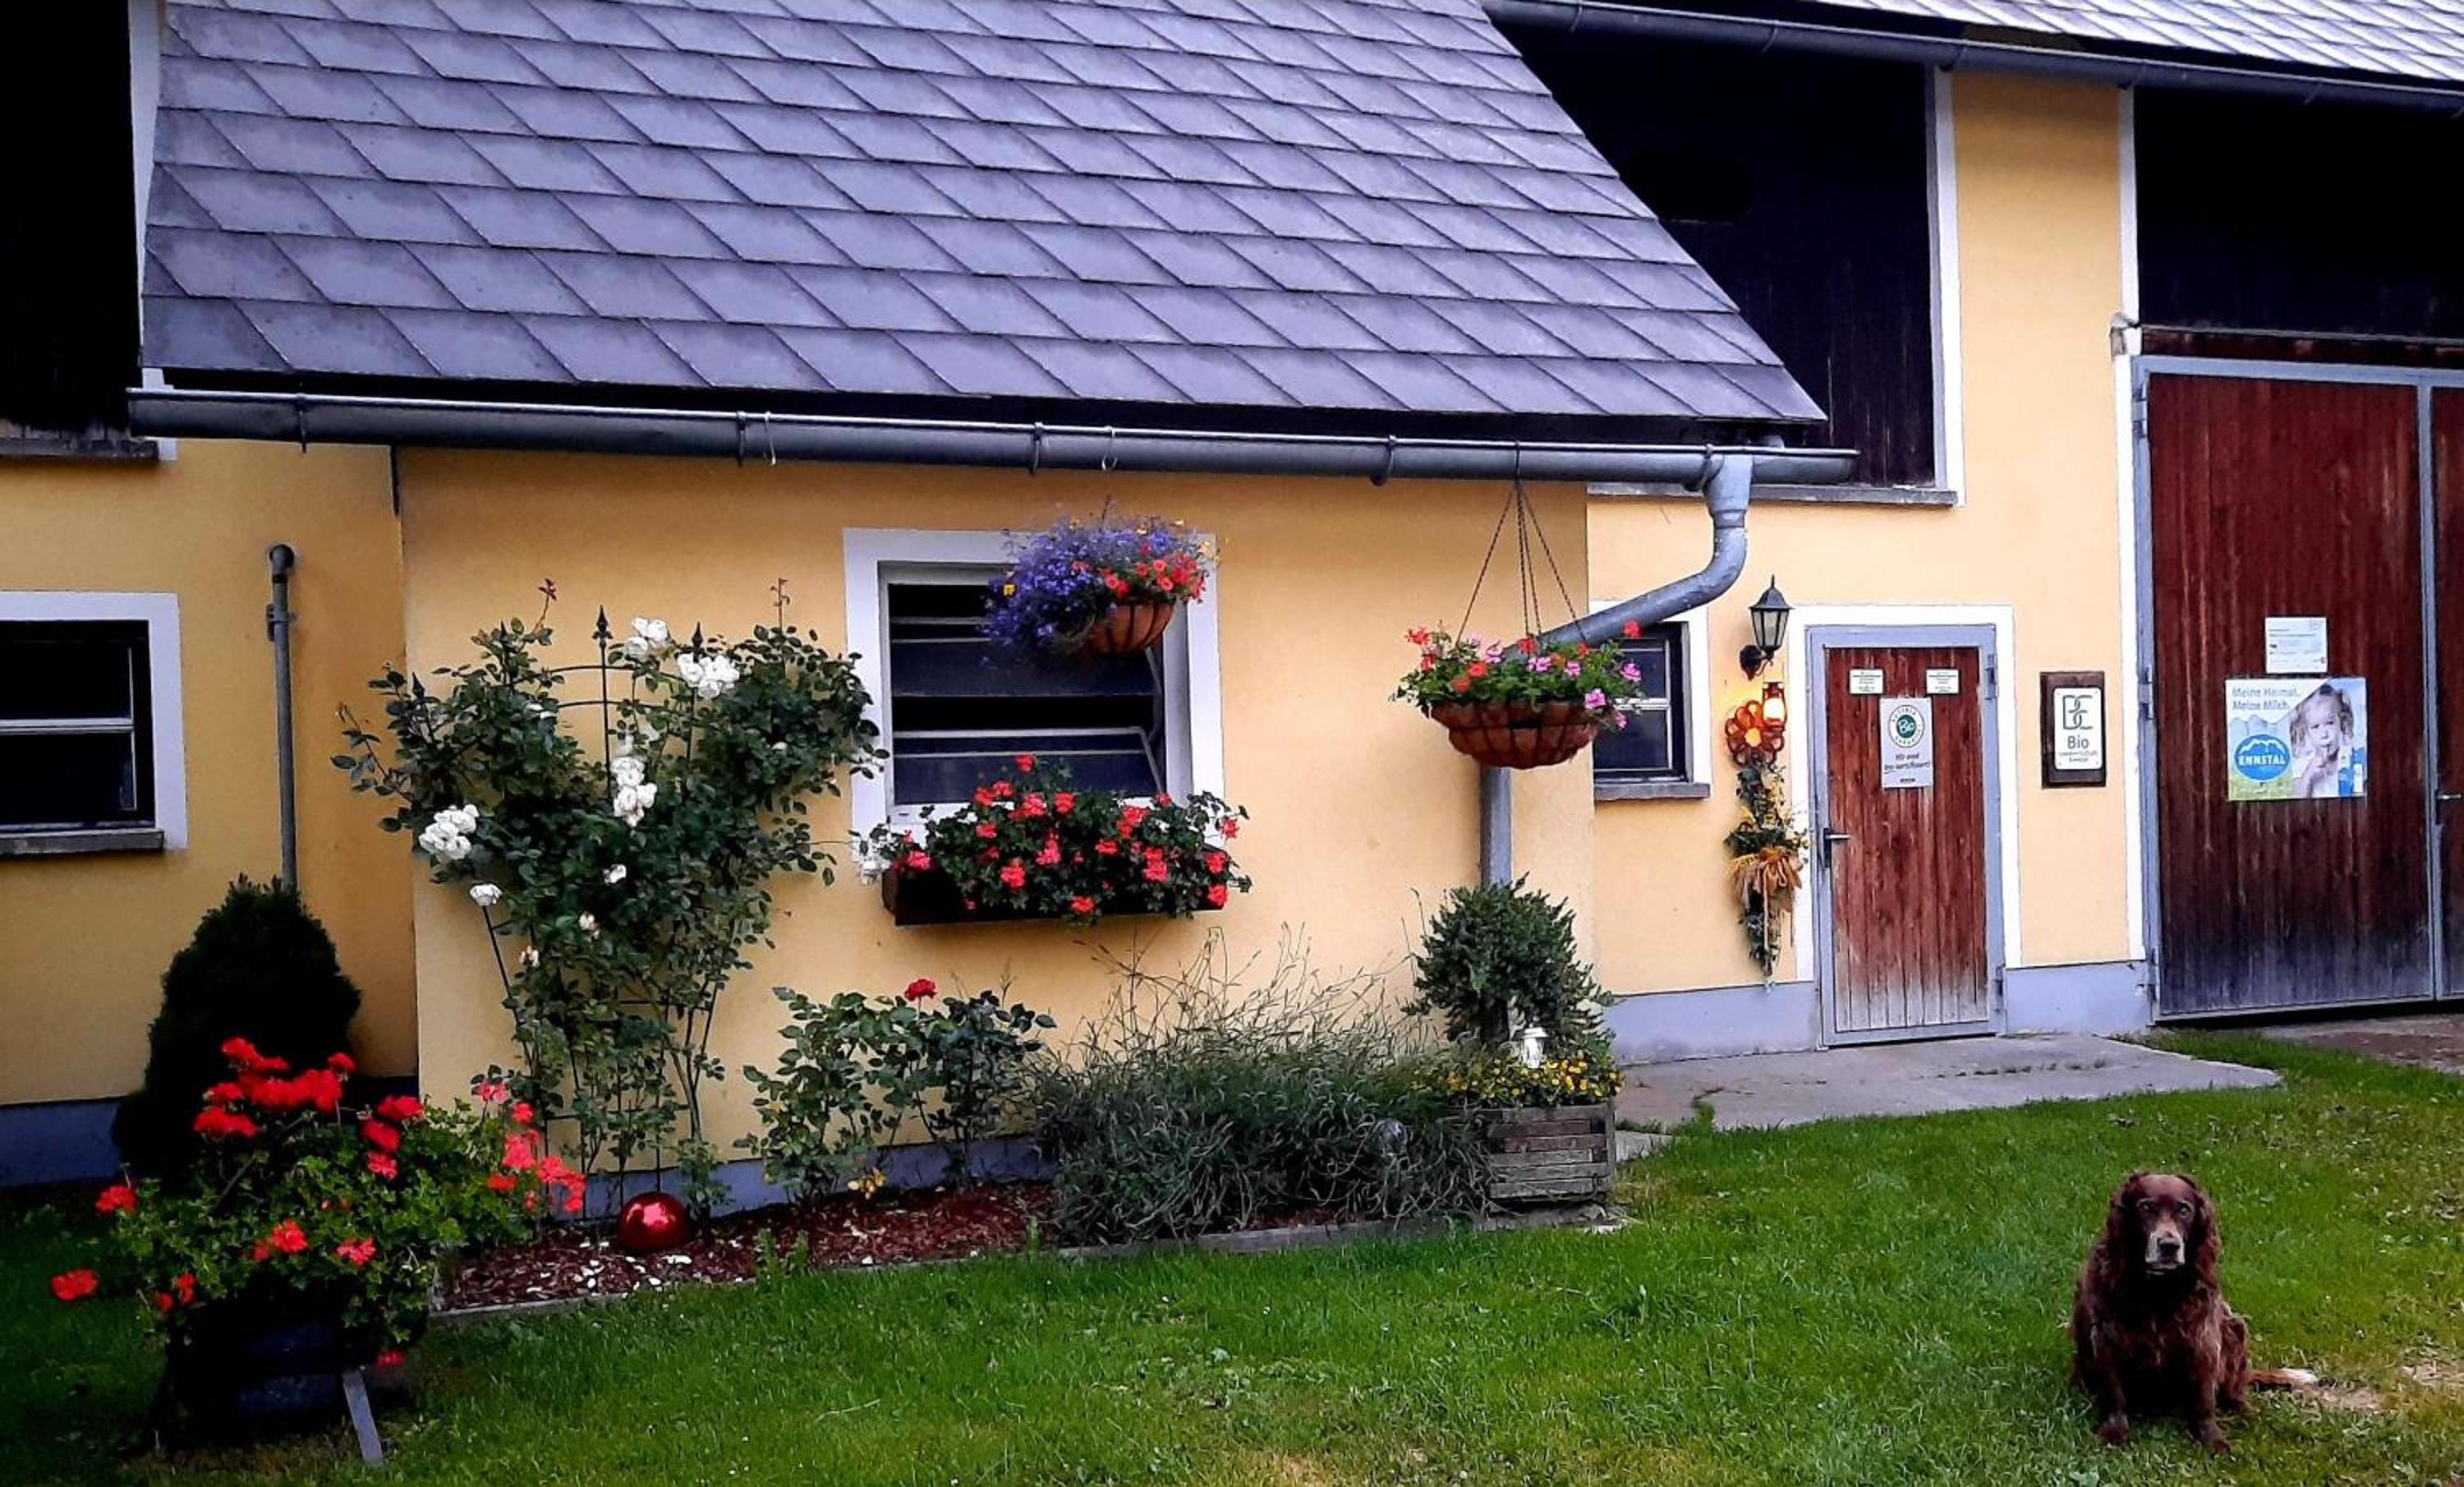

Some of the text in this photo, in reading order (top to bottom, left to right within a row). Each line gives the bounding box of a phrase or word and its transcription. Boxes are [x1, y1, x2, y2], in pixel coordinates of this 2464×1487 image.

[2232, 687, 2260, 697] Meine
[2232, 700, 2260, 711] Meine
[2067, 734, 2089, 749] Bio
[2238, 755, 2287, 765] ENNSTAL
